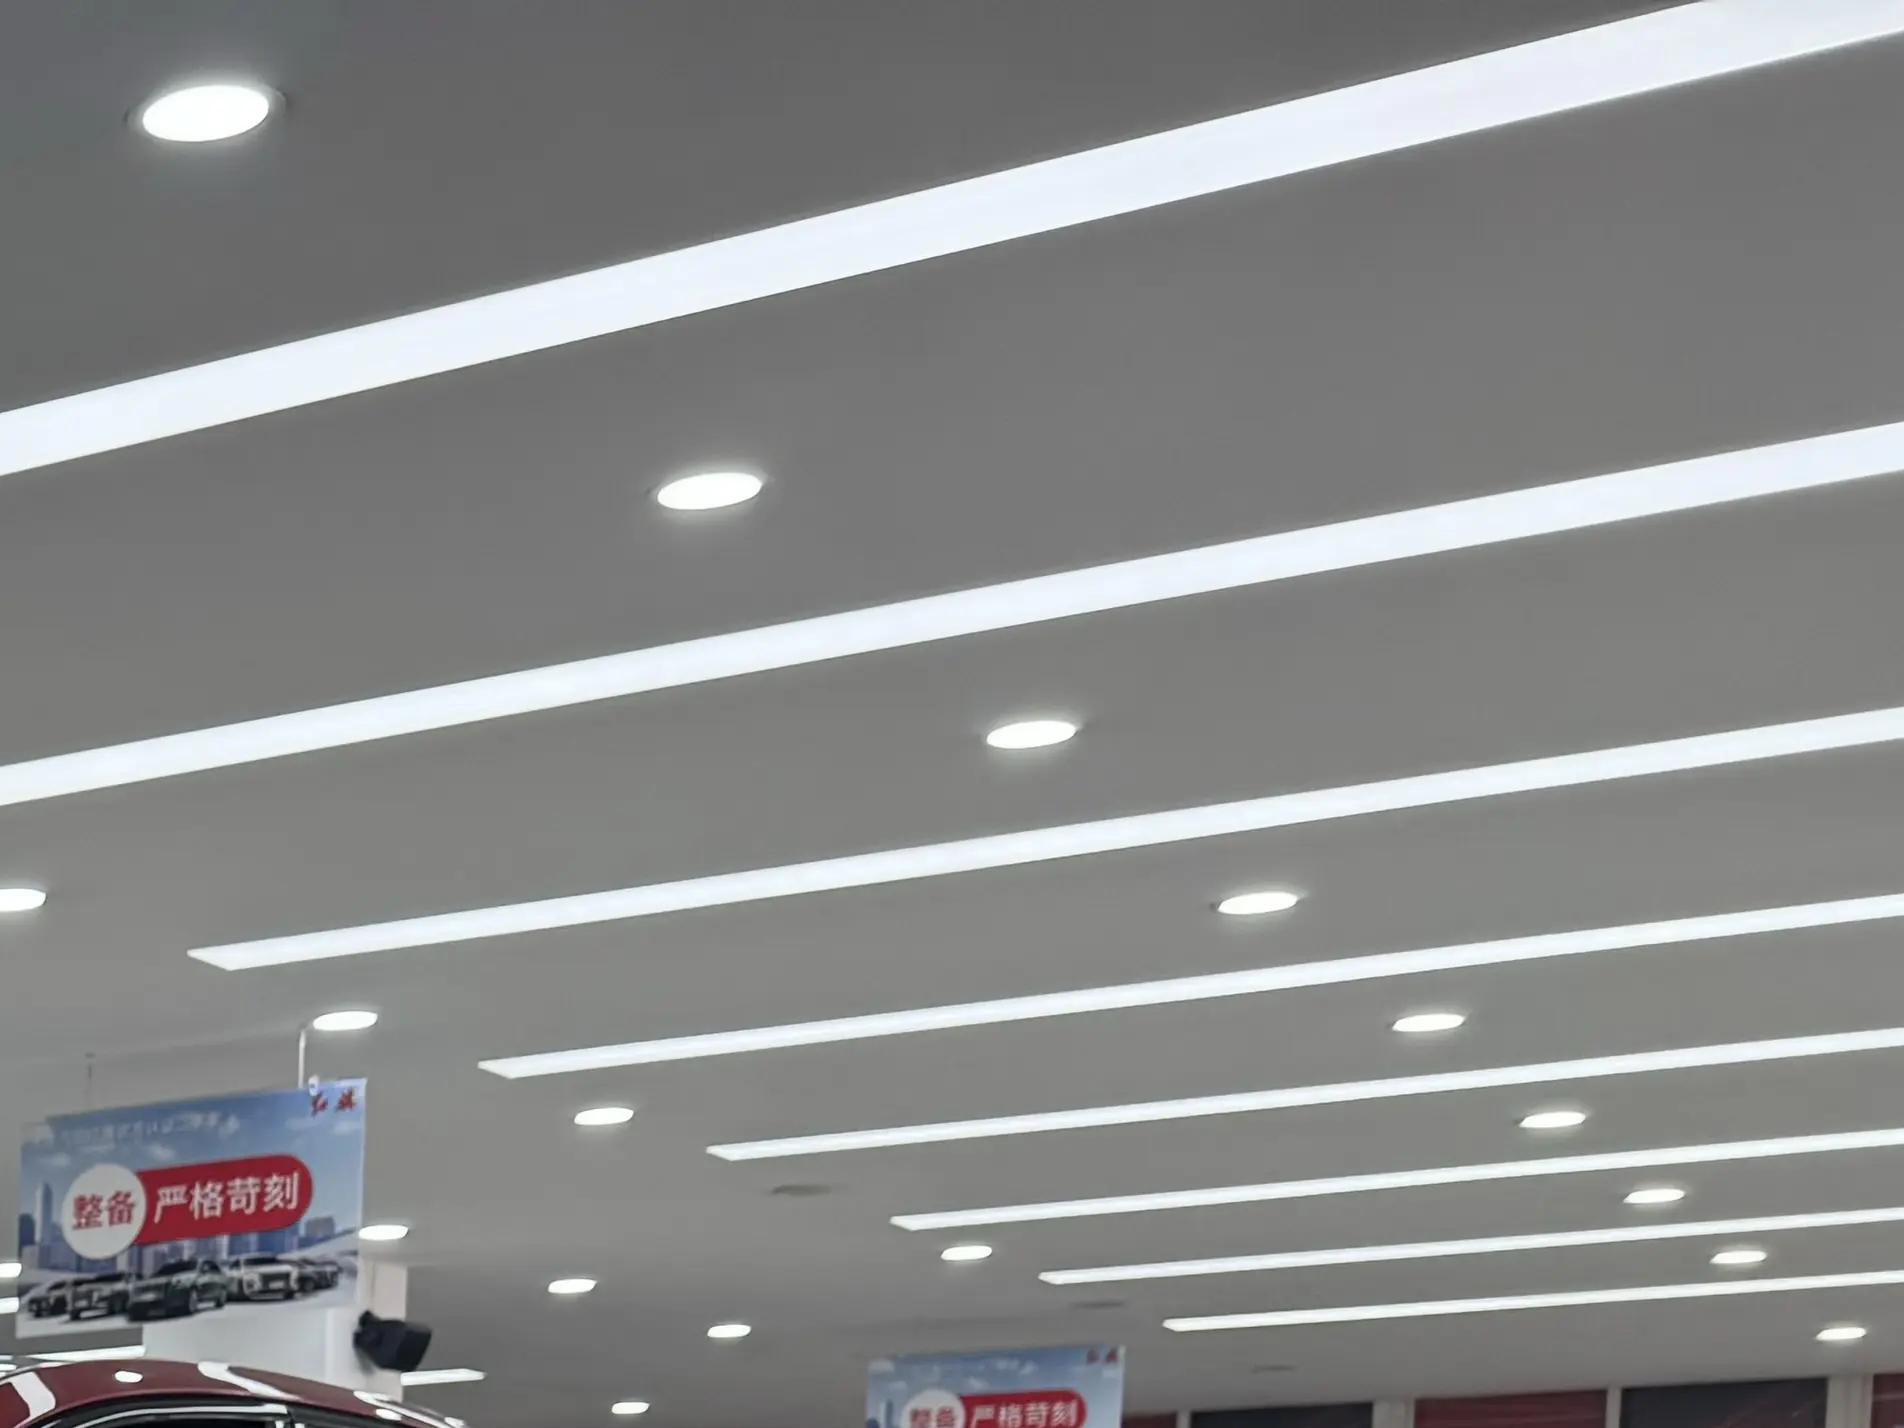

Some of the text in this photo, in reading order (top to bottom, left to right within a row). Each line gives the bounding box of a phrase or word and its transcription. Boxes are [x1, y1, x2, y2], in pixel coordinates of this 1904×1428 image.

[73, 1171, 300, 1231] 整备 严格苛刻
